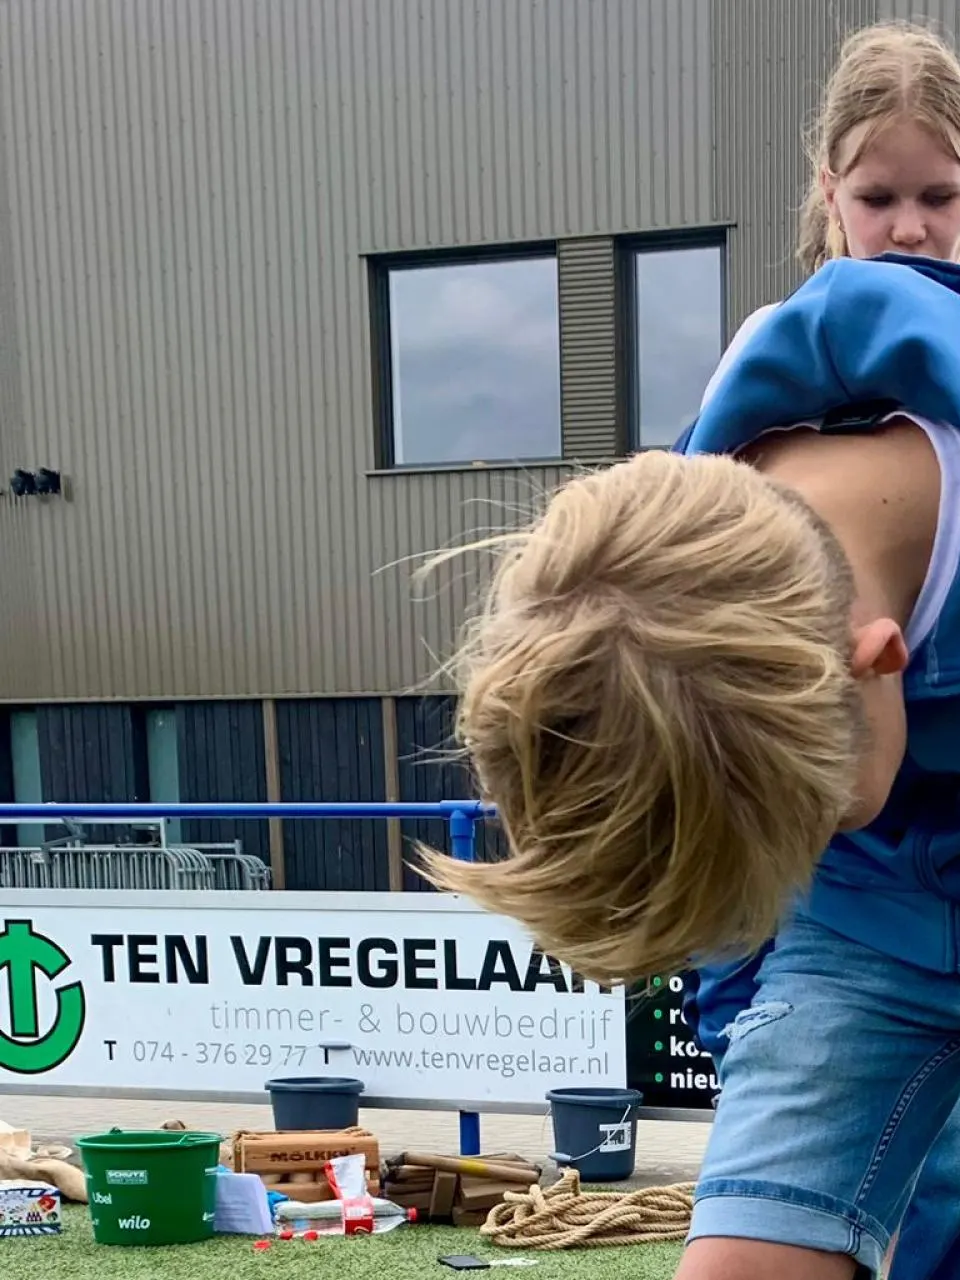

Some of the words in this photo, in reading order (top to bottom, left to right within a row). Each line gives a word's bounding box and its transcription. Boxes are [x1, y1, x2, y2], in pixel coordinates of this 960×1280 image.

[90, 933, 210, 985] TEN
[209, 1000, 343, 1031] timmer-
[358, 1003, 381, 1034] &
[397, 1003, 614, 1049] bouwbedrijf
[103, 1039, 117, 1061] T
[133, 1040, 175, 1062] 074
[195, 1042, 238, 1064] 376
[244, 1043, 272, 1066] 29
[279, 1044, 307, 1067] 77
[353, 1047, 609, 1078] www.tenvregelaar.nl
[118, 1215, 151, 1229] wilo
